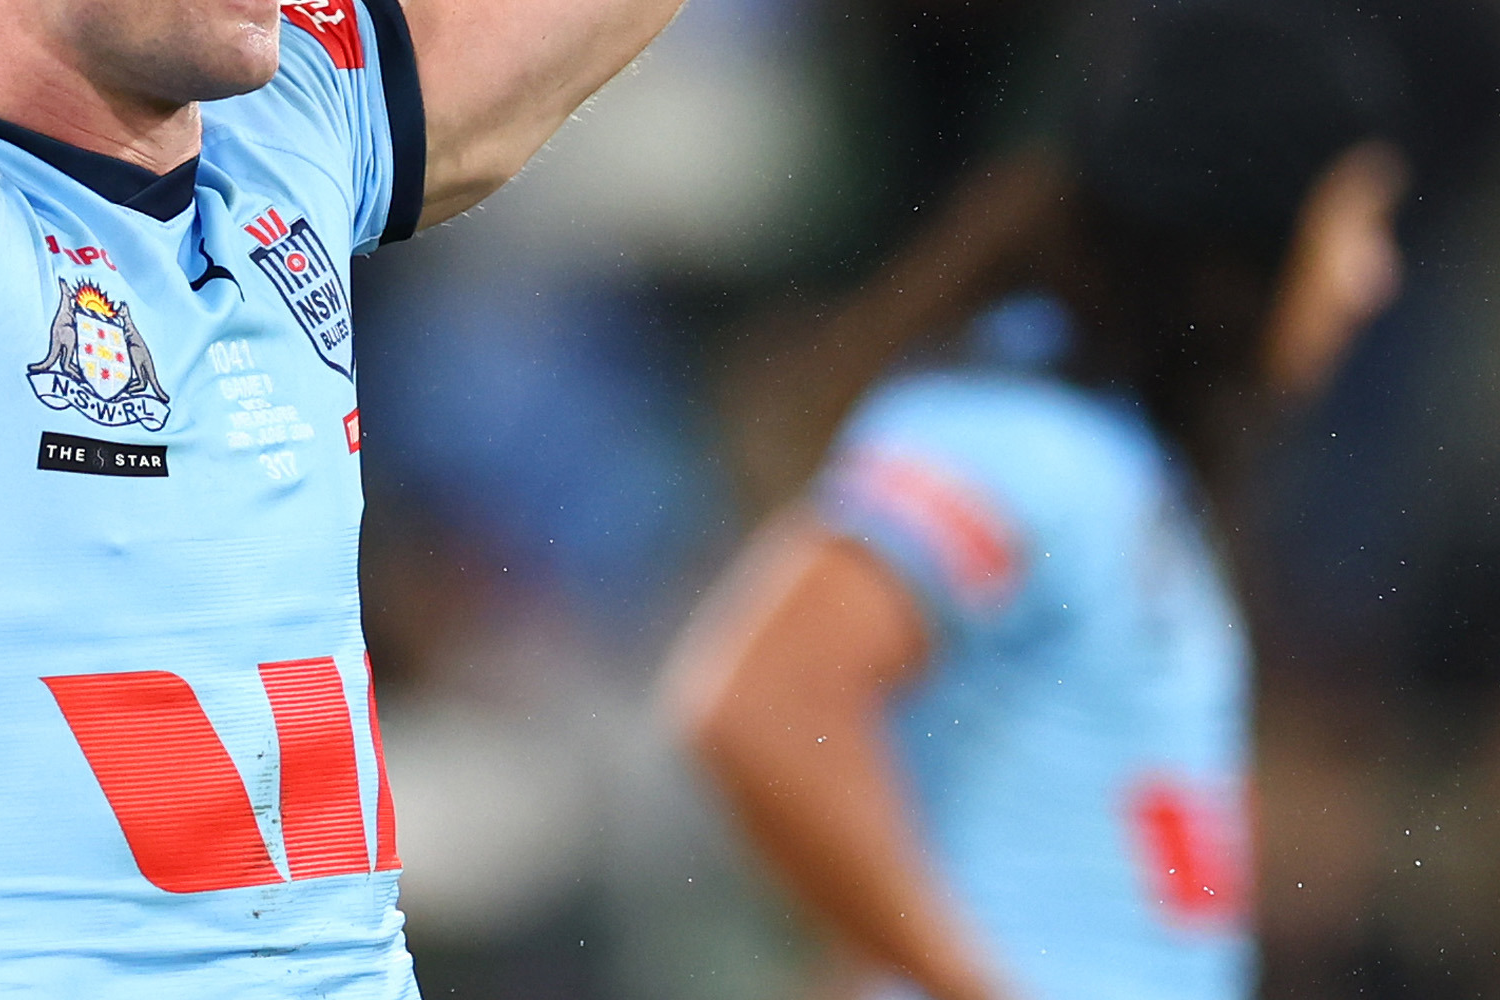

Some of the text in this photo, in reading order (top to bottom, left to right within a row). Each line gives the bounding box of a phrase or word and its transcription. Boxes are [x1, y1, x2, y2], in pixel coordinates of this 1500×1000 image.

[296, 279, 342, 329] NSW
[320, 318, 350, 351] BLUES
[208, 339, 255, 374] 1041
[46, 444, 162, 467] THE STAR
[258, 451, 299, 480] 317
